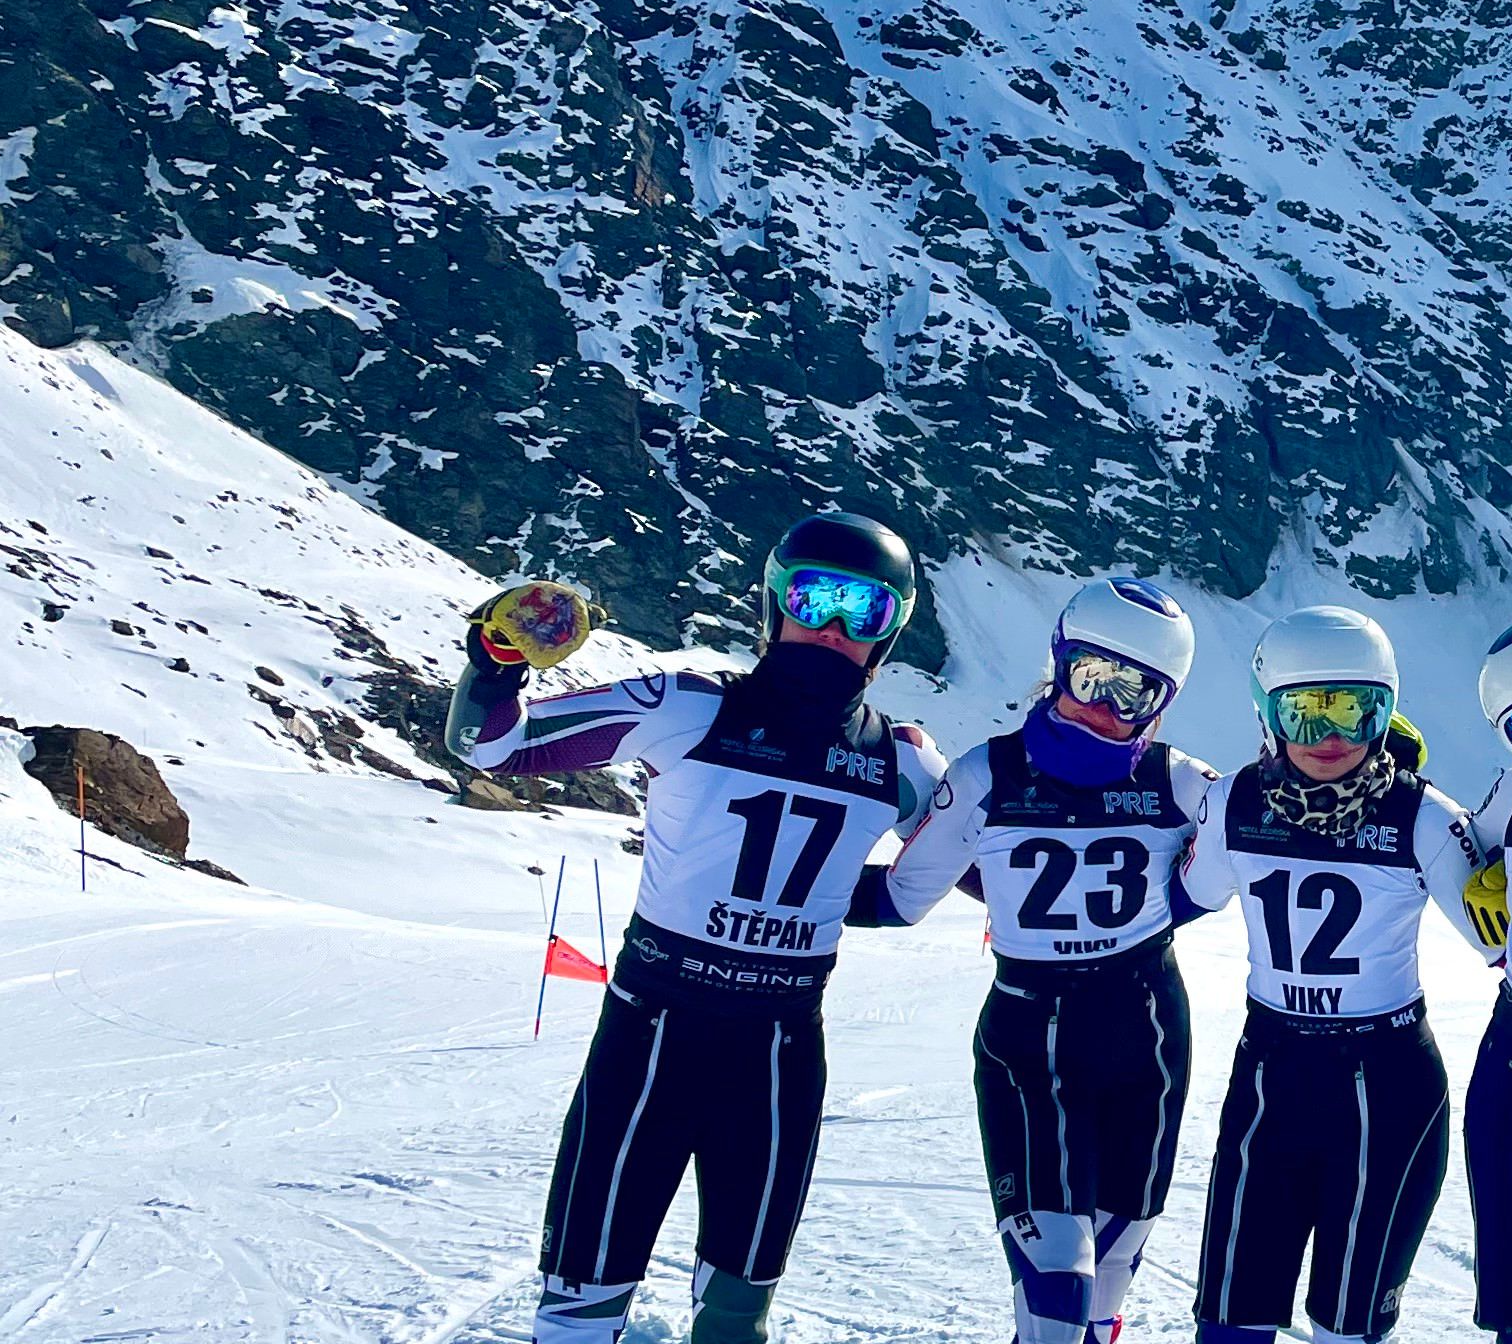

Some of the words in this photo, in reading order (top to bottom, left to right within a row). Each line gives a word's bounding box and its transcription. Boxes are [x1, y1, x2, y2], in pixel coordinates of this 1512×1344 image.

[825, 746, 886, 785] PRE
[1102, 791, 1162, 816] PRE
[727, 789, 847, 909] 17
[1447, 819, 1480, 868] DON
[1009, 837, 1150, 930] 23
[705, 900, 817, 951] ŠTĚPÁN
[1249, 869, 1362, 976] 12
[1282, 983, 1343, 1015] VIKY
